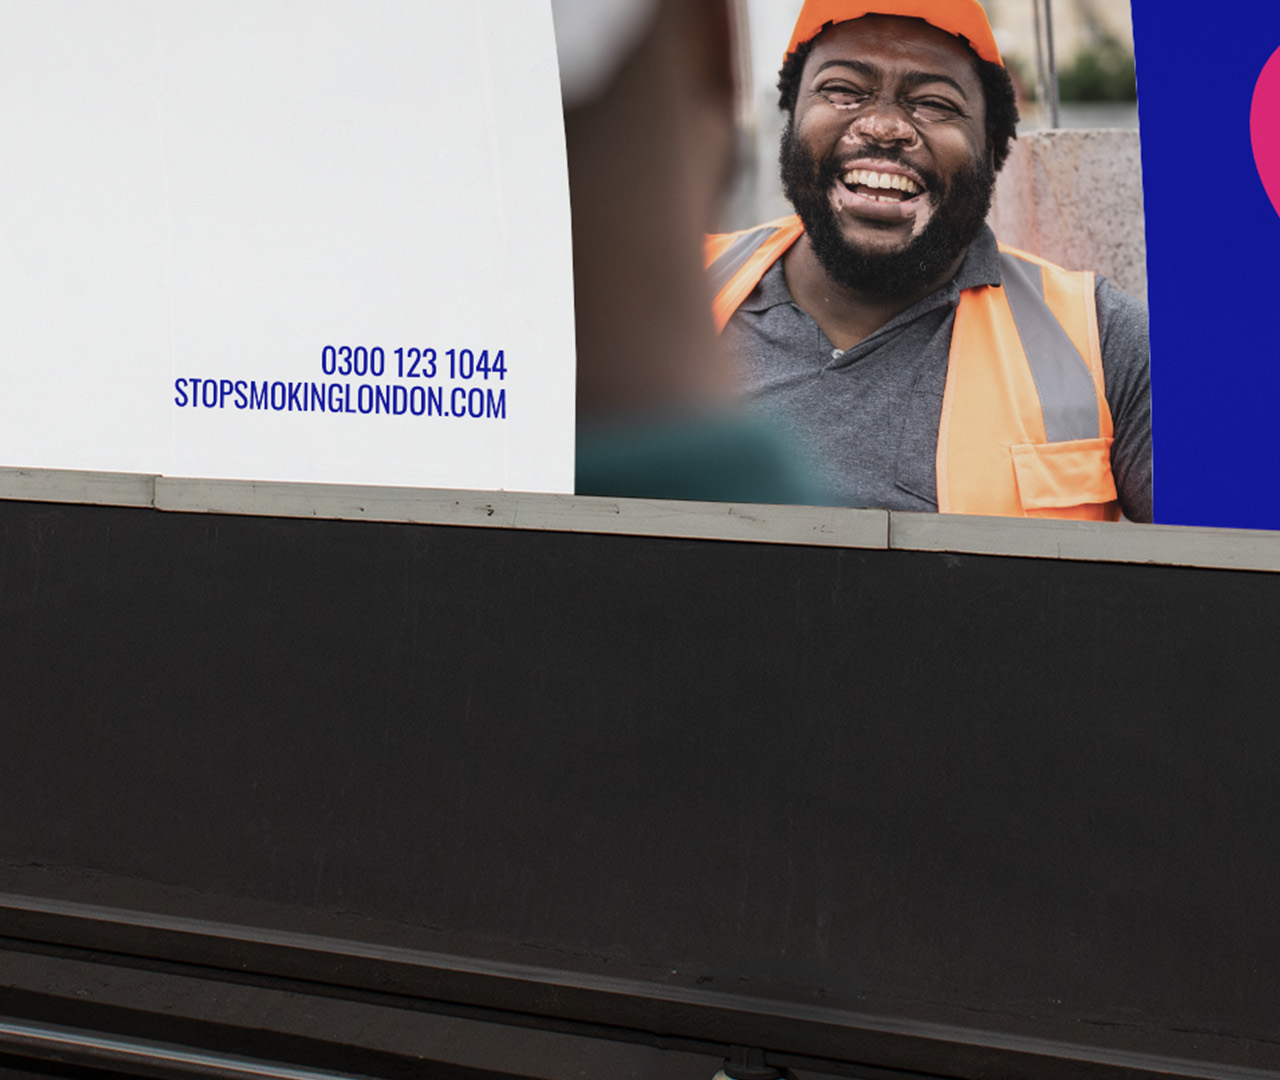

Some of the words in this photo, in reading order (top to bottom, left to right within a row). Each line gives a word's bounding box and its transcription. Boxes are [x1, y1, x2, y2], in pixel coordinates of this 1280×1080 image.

[321, 345, 385, 377] 0300
[393, 347, 438, 379] 123
[446, 348, 508, 381] 1044
[174, 377, 507, 419] STOPSMOKINGLONDON.COM
